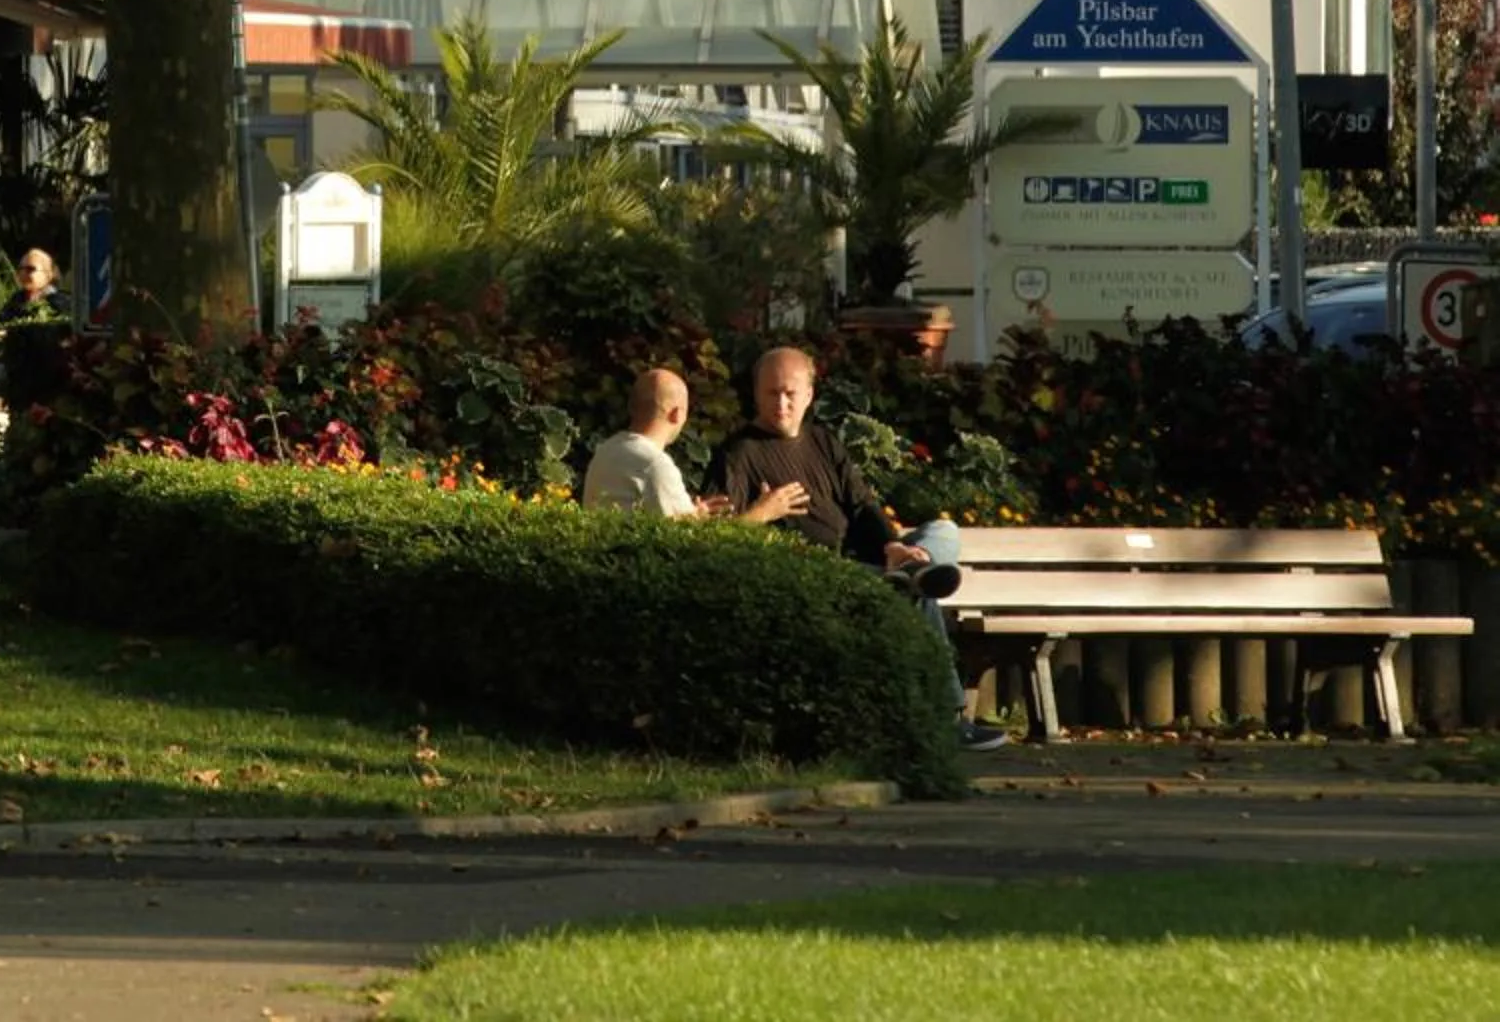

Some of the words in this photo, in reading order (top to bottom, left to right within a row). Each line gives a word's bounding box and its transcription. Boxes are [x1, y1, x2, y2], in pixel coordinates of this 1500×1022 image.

[1032, 32, 1067, 48] am
[1076, 24, 1204, 49] Yachthafen
[1145, 114, 1222, 131] KNAUS
[1139, 181, 1156, 200] P
[1437, 291, 1457, 326] 3
